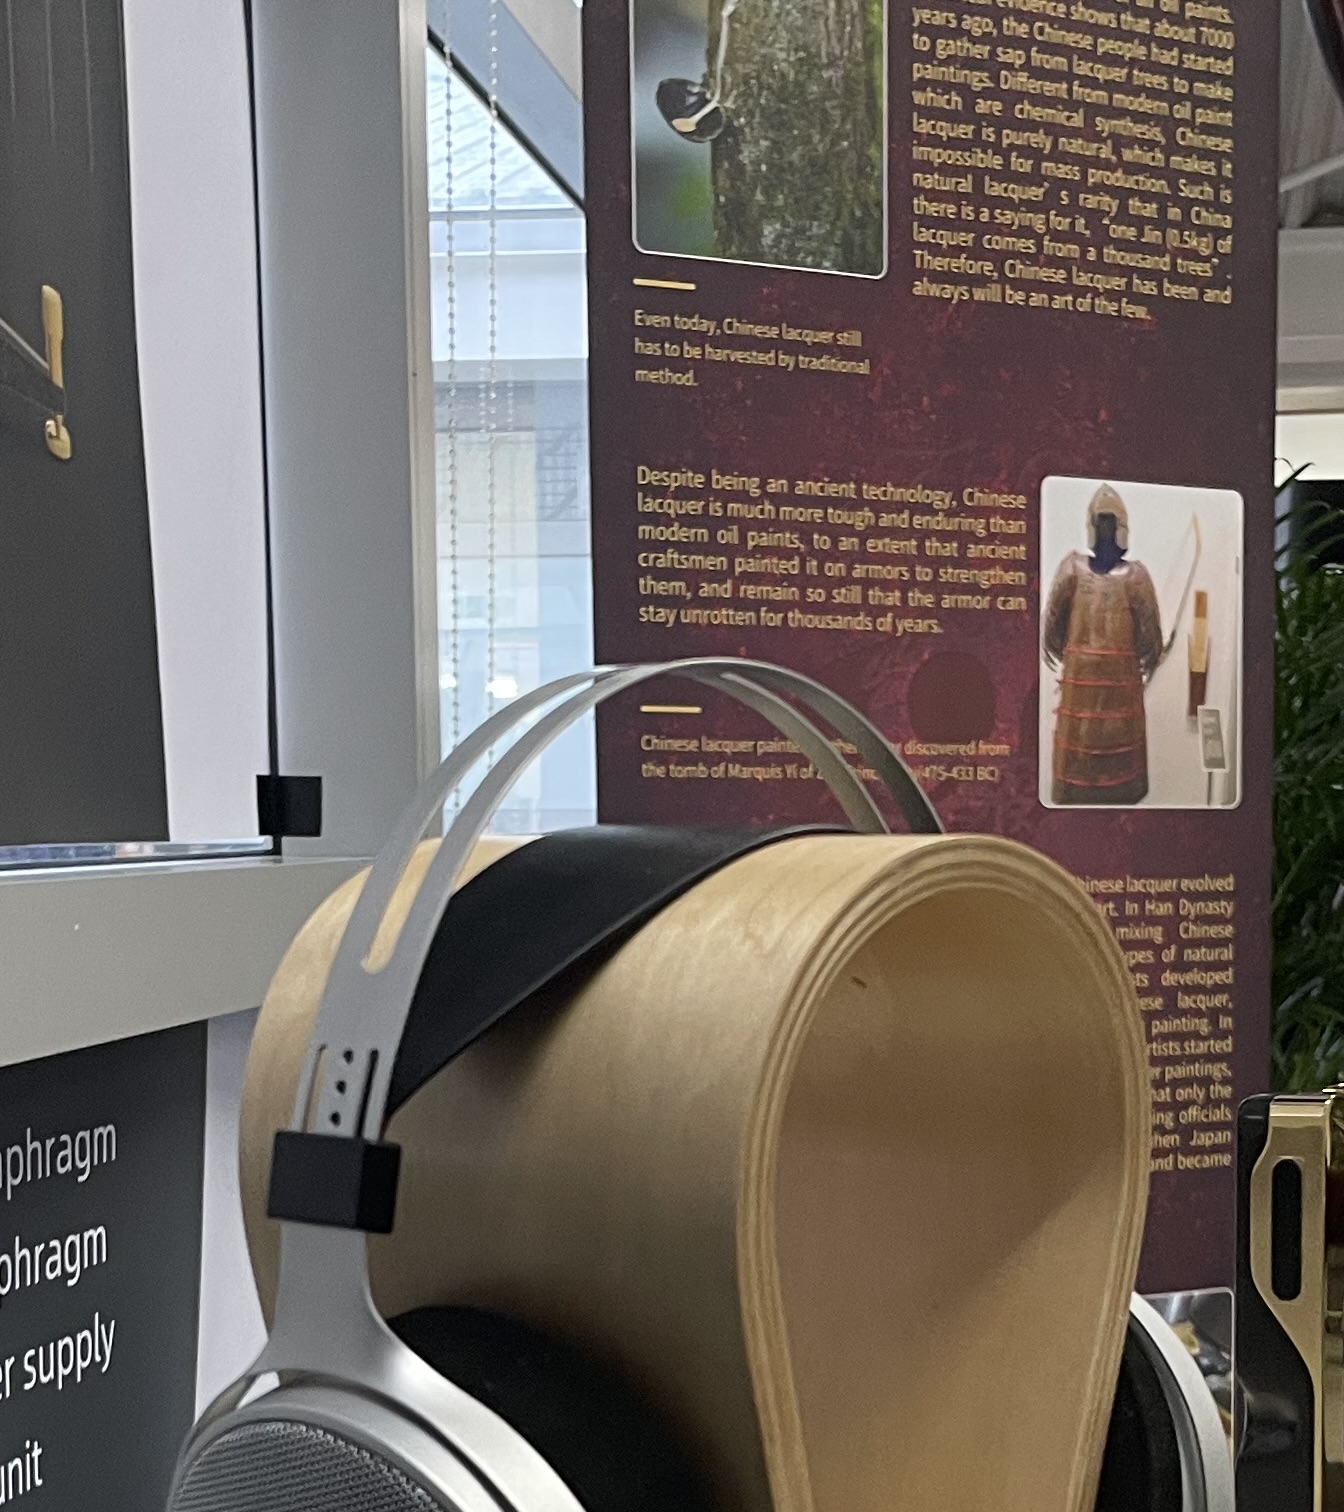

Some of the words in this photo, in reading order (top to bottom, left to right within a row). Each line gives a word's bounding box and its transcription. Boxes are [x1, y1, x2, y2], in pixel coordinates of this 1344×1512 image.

[912, 7, 957, 28] years
[961, 14, 997, 37] ago,
[1002, 16, 1029, 38] the
[912, 32, 930, 51] to
[936, 37, 990, 59] gather
[996, 46, 1026, 68] sap
[1031, 46, 1068, 72] from
[912, 87, 962, 110] which
[975, 98, 1003, 116] are
[912, 112, 976, 141] lacquer
[982, 121, 996, 142] is
[1002, 128, 1053, 154] purely
[912, 141, 1003, 170] impossible
[1010, 152, 1032, 172] for
[912, 172, 973, 193] natural
[913, 194, 956, 219] there
[961, 200, 974, 220] is
[979, 207, 990, 222] a
[994, 207, 1046, 233] saying
[1049, 210, 1072, 231] for
[912, 221, 975, 249] lacquer
[982, 234, 1037, 254] comes
[1043, 235, 1080, 258] from
[1087, 247, 1096, 260] a
[1103, 244, 1170, 271] thousand
[912, 250, 998, 280] Therefore,
[1004, 258, 1068, 284] Chinese
[1072, 266, 1128, 292] lacquer
[1133, 272, 1158, 295] has
[1163, 278, 1198, 300] been
[1203, 285, 1232, 304] and
[912, 276, 970, 304] always
[972, 282, 1002, 302] will
[1006, 284, 1026, 306] be
[1028, 292, 1048, 308] an
[1052, 293, 1074, 310] art
[1076, 293, 1092, 312] of
[1094, 296, 1118, 316] the
[634, 309, 671, 328] Even
[674, 313, 722, 337] today,
[722, 318, 779, 339] Chinese
[782, 323, 834, 346] lacquer
[836, 330, 862, 347] still
[634, 337, 661, 356] has
[664, 340, 680, 357] to
[683, 341, 702, 359] be
[705, 343, 776, 366] harvested
[778, 350, 795, 372] by
[798, 354, 870, 375] traditional
[634, 367, 698, 386] method.
[636, 466, 705, 491] Despite
[711, 469, 762, 496] being
[766, 478, 788, 493] an
[794, 476, 857, 498] ancient
[862, 481, 957, 509] technology,
[962, 487, 1026, 508] Chinese
[638, 492, 705, 518] lacquer
[709, 497, 723, 516] is
[727, 498, 776, 519] much
[779, 506, 824, 523] more
[827, 506, 875, 530] tough
[878, 510, 909, 528] and
[912, 512, 986, 537] enduring
[990, 515, 1026, 534] than
[638, 522, 708, 542] modern
[716, 525, 739, 544] oil
[748, 527, 805, 550] paints,
[813, 532, 831, 550] to
[838, 536, 859, 550] an
[866, 537, 917, 555] extent
[925, 537, 958, 556] that
[967, 540, 1026, 560] ancient
[638, 548, 728, 570] craftsmen
[735, 554, 800, 576] painted
[806, 556, 818, 575] it
[824, 562, 846, 577] on
[852, 563, 910, 580] armors
[915, 564, 933, 581] to
[938, 565, 1026, 588] strengthen
[639, 576, 692, 600] them,
[698, 579, 732, 598] and
[740, 581, 800, 600] remain
[806, 588, 826, 602] so
[832, 585, 862, 604] still
[868, 586, 902, 606] that
[908, 588, 935, 608] the
[941, 594, 990, 609] armor
[996, 596, 1027, 610] can
[639, 606, 677, 628] stay
[680, 608, 756, 626] unrotten
[760, 607, 784, 626] for
[788, 608, 872, 630] thousands
[876, 612, 894, 632] of
[896, 618, 944, 636] years.
[640, 735, 699, 752] Chinese
[642, 762, 666, 777] the
[669, 762, 708, 778] tomb
[1126, 874, 1178, 894] lacquer
[1180, 874, 1234, 892] evolved
[1126, 900, 1138, 916] In
[1145, 900, 1173, 916] Han
[1178, 898, 1234, 920] Dynasty
[1116, 922, 1163, 944] mixing
[1178, 922, 1234, 938] Chinese
[1162, 944, 1178, 962] of
[1183, 944, 1234, 962] natural
[1161, 968, 1234, 988] developed
[1152, 1014, 1212, 1036] painting.
[1219, 1014, 1232, 1030] In
[1184, 1036, 1232, 1054] started
[1176, 1083, 1206, 1105] only
[1210, 1082, 1232, 1099] the
[1179, 1104, 1232, 1124] officials
[1189, 1130, 1231, 1147] Japan
[1178, 1152, 1231, 1170] became
[24, 1313, 116, 1392] supply
